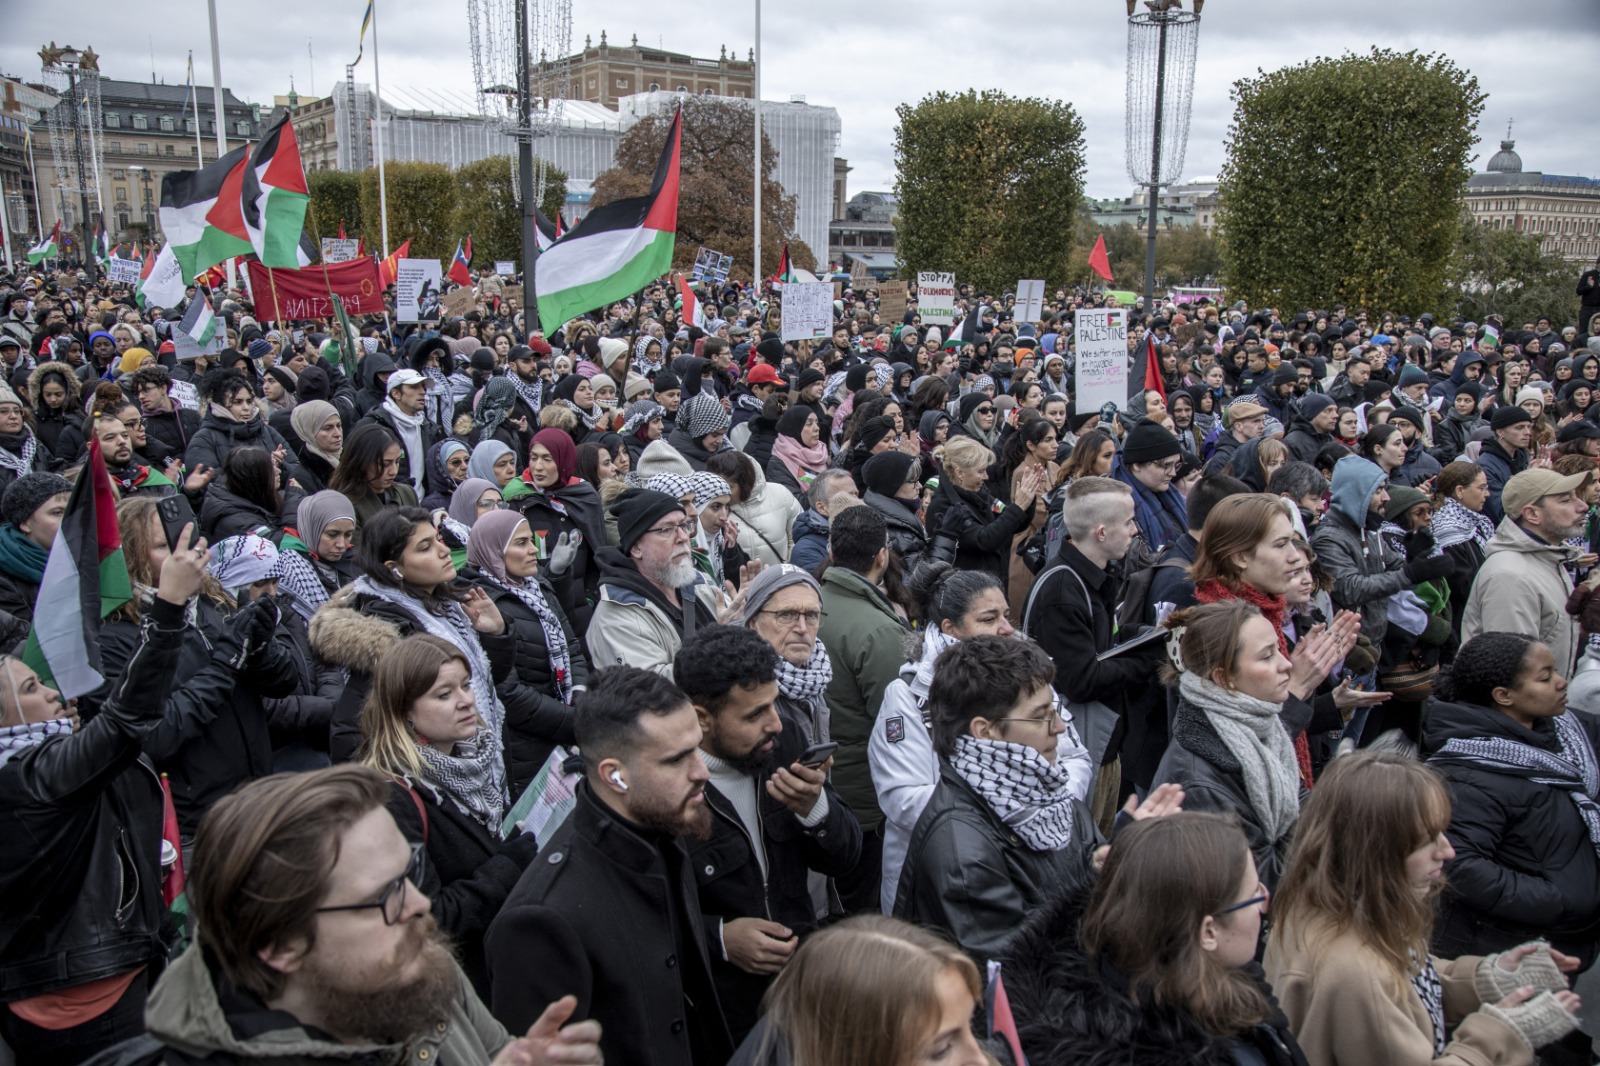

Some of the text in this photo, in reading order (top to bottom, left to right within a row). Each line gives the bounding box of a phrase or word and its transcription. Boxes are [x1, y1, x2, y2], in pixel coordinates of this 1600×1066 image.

[117, 274, 132, 282] FREE
[921, 272, 954, 284] STOPPA
[919, 287, 955, 296] FOLKMORDET
[919, 308, 954, 317] PALESTINA
[1079, 313, 1107, 328] FREE
[1080, 327, 1126, 342] PALESTINE
[1081, 347, 1126, 358] We suffer from
[1089, 359, 1113, 369] incurable
